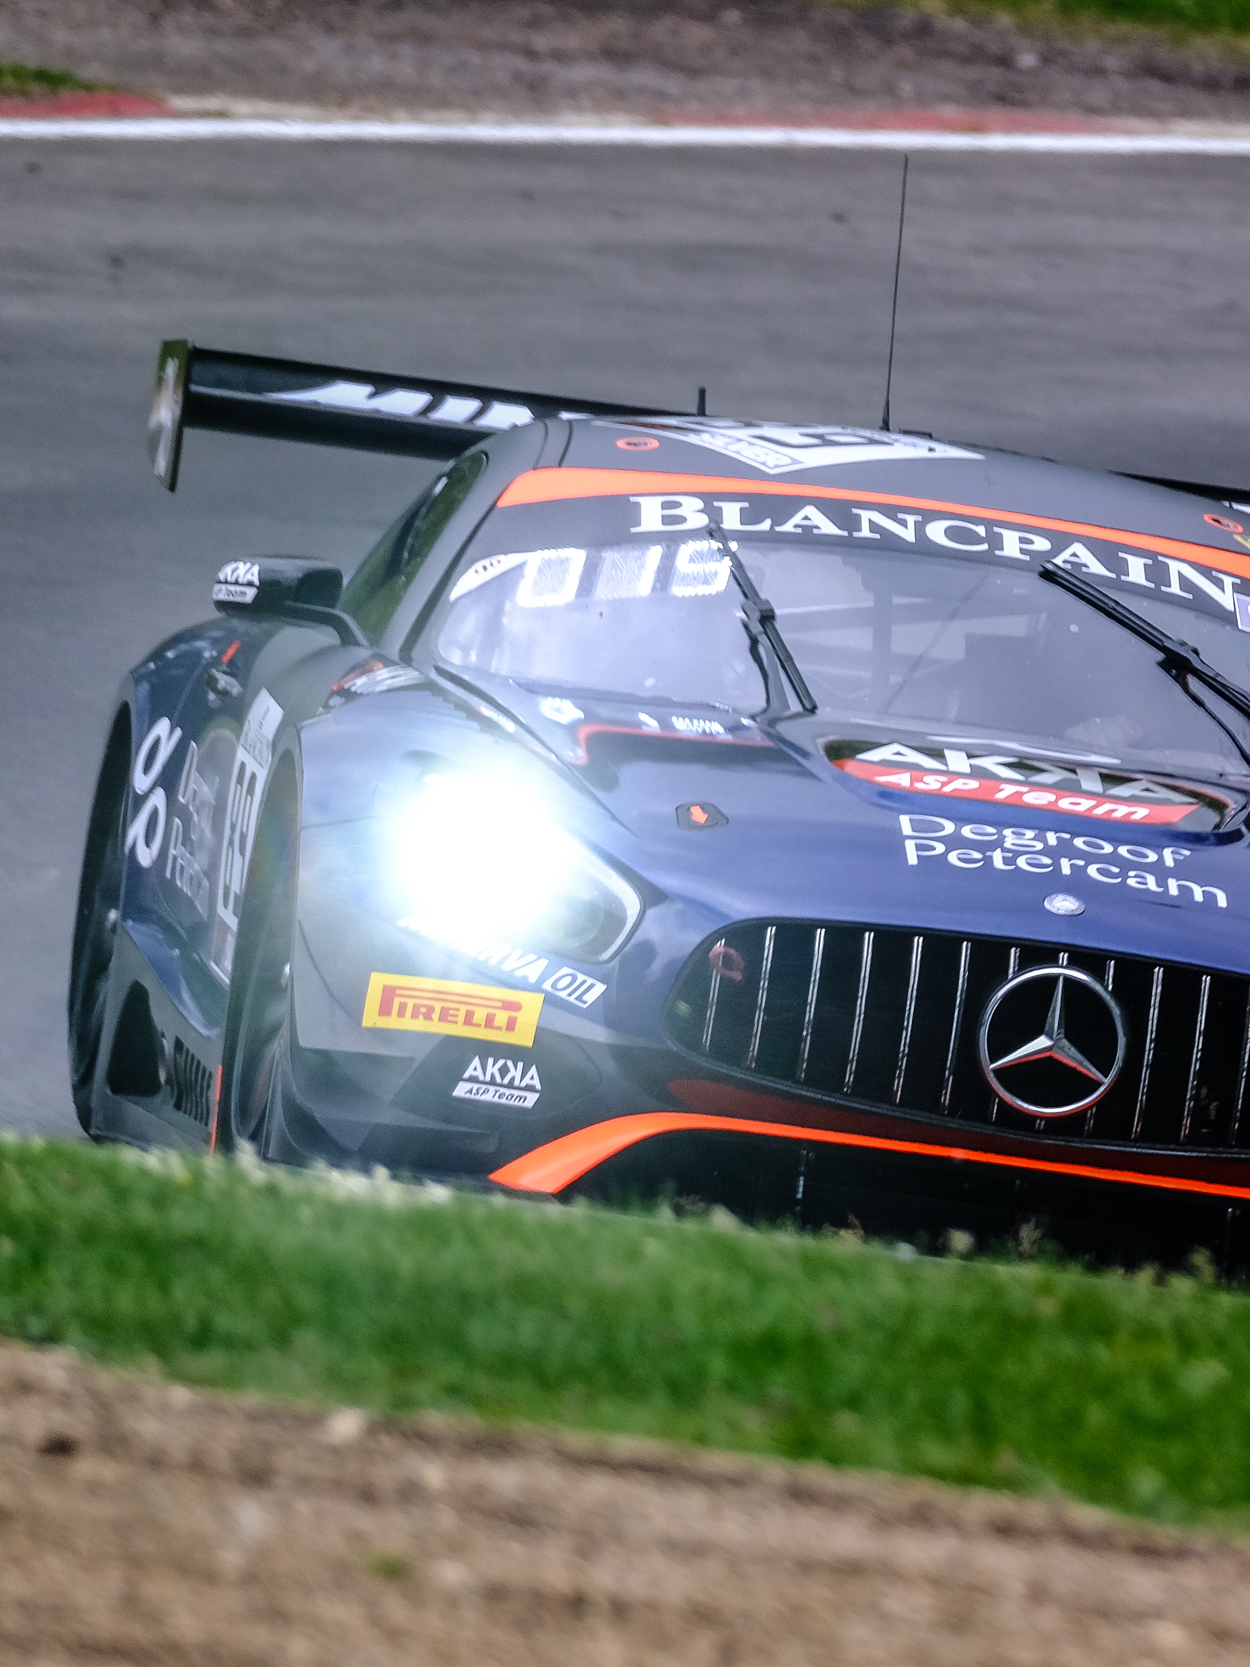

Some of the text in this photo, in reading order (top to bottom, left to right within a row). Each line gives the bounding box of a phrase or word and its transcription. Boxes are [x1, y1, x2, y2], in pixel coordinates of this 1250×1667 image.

[630, 495, 1241, 612] BLANCPAIN
[855, 741, 1202, 806] AKKA
[872, 772, 1152, 821] ASP Team
[899, 813, 1192, 868] Degroof
[903, 838, 1229, 909] Petercam
[378, 984, 523, 1033] PIRELLI
[550, 970, 600, 1007] OIL
[462, 1054, 542, 1090] AKKA
[463, 1085, 528, 1104] ASP Team
